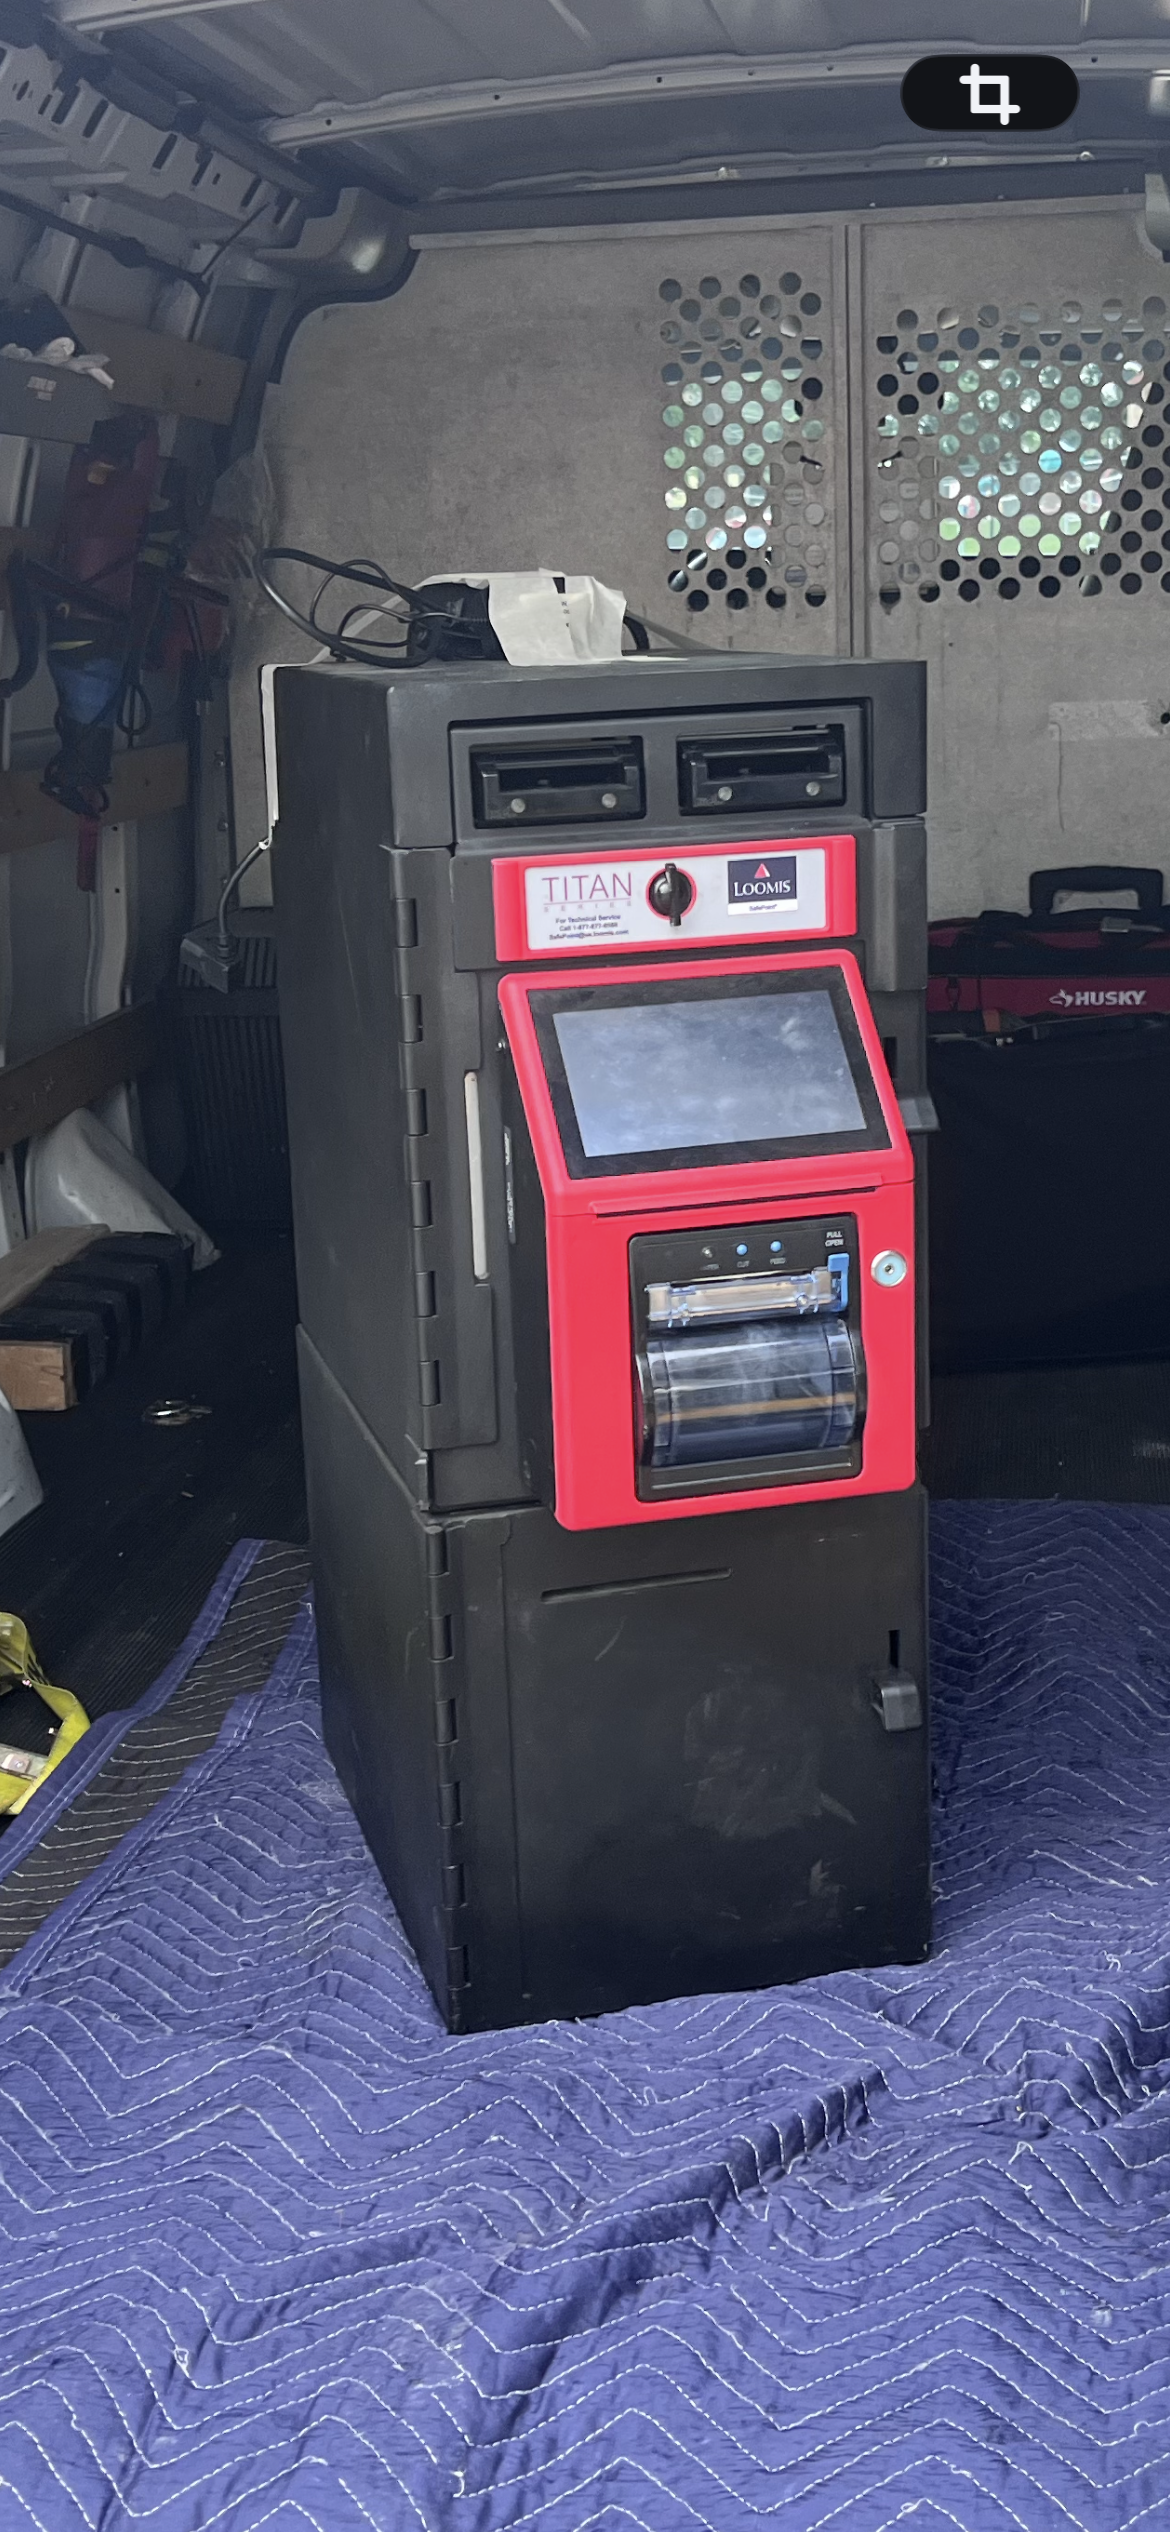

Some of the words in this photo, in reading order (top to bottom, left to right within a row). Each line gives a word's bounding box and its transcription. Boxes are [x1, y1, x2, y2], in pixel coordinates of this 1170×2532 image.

[541, 872, 632, 902] TITAN
[733, 880, 791, 897] LOOMIS
[568, 915, 597, 923] Technical
[1074, 990, 1147, 1006] HUSKY
[824, 1238, 844, 1248] OPEN
